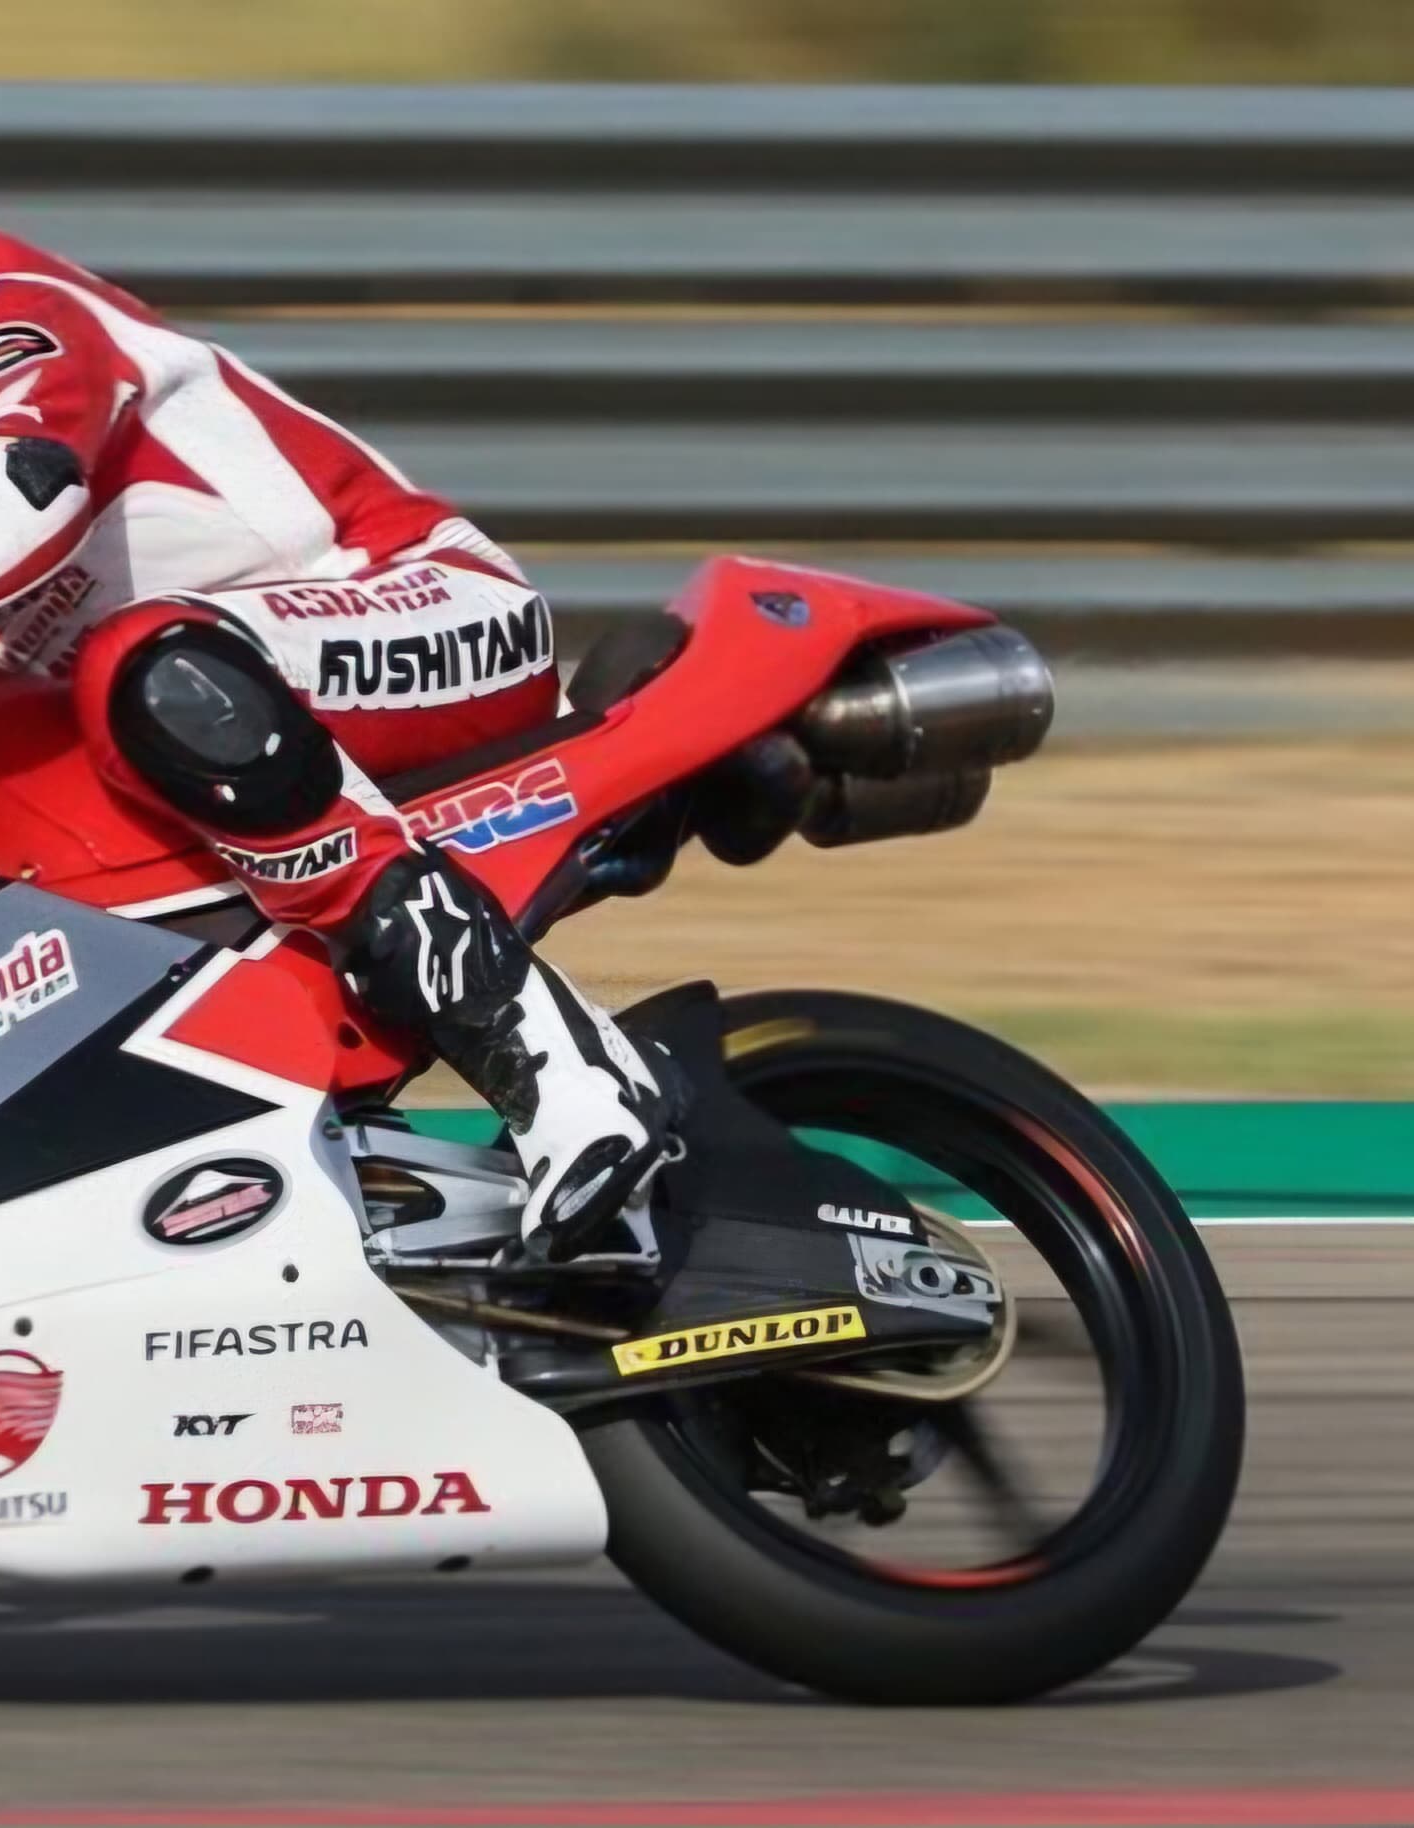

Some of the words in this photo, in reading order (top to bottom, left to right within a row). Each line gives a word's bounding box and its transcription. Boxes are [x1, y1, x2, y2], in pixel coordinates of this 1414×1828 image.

[144, 1318, 369, 1361] FIFASTRA
[659, 1312, 853, 1361] DUNLOP
[172, 1412, 259, 1437] KYT
[137, 1471, 492, 1525] HONDA
